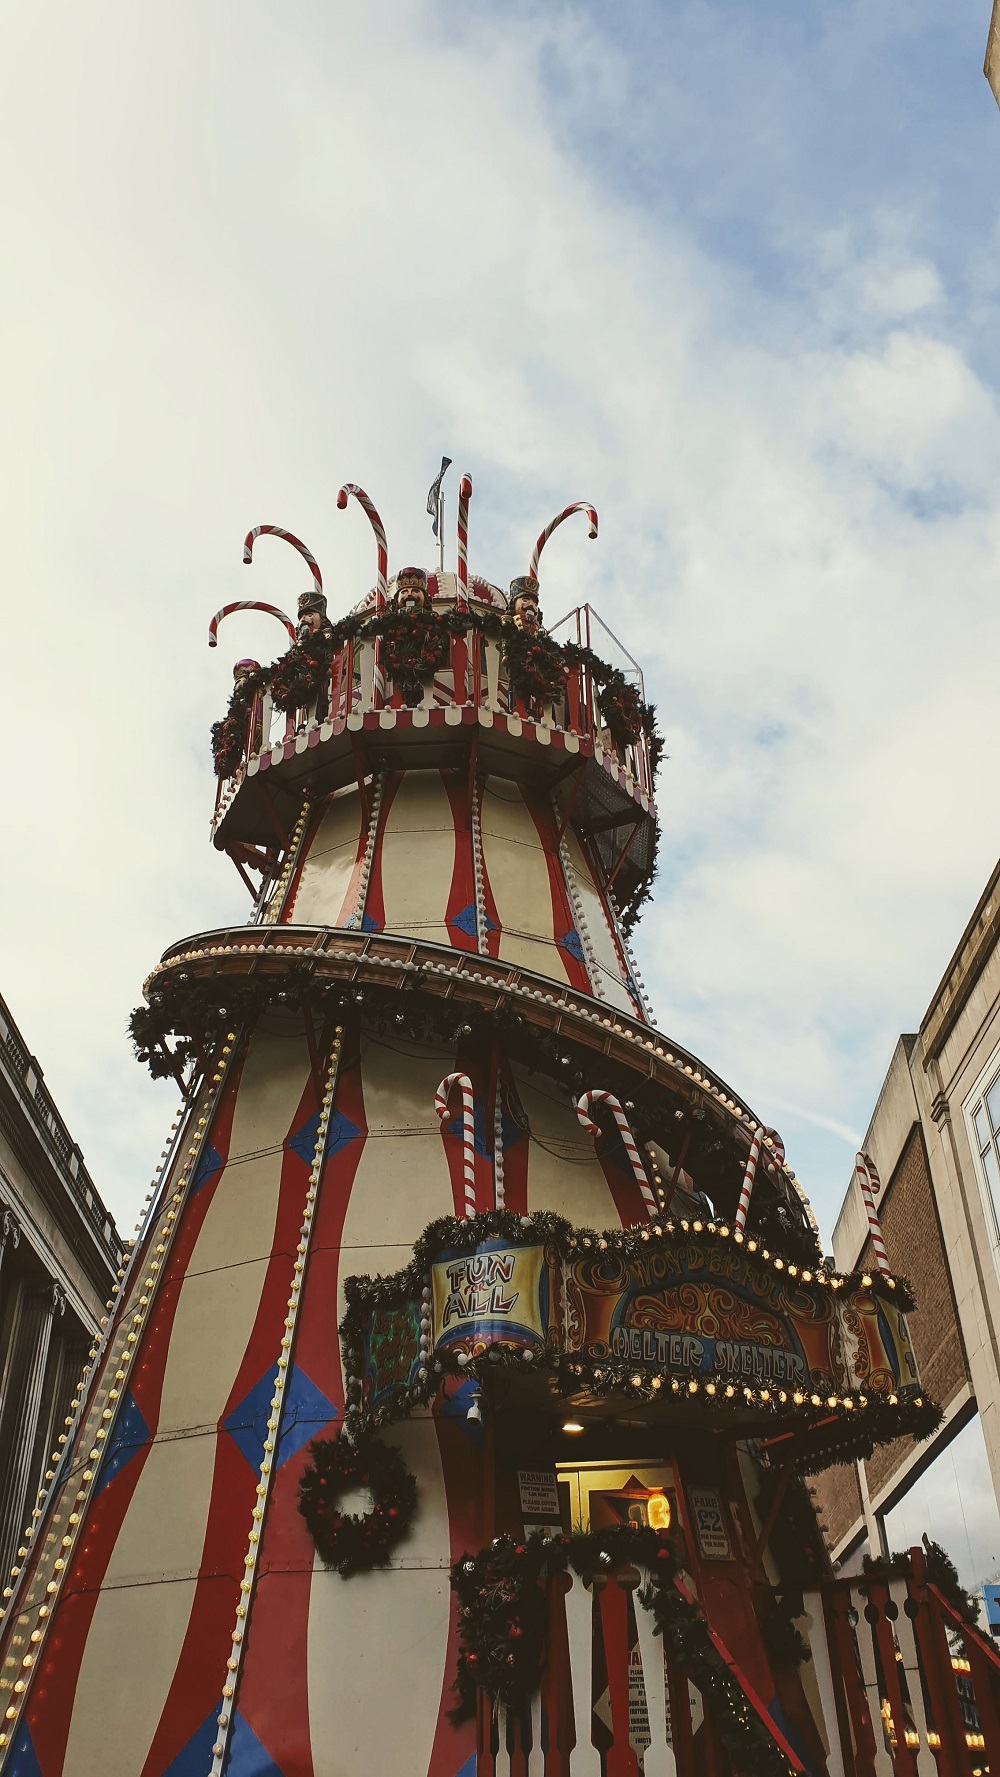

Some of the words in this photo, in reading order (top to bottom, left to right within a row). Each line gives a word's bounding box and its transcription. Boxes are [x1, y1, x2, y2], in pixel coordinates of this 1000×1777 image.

[446, 1254, 516, 1293] FUN
[628, 1245, 781, 1312] WONDERFUL
[463, 1284, 489, 1295] FOR
[443, 1285, 520, 1328] ALL
[611, 1326, 705, 1368] HELTER
[714, 1340, 806, 1384] SKELTER
[520, 1472, 554, 1483] WARNING
[693, 1497, 717, 1507] FARE
[697, 1510, 723, 1531] £2
